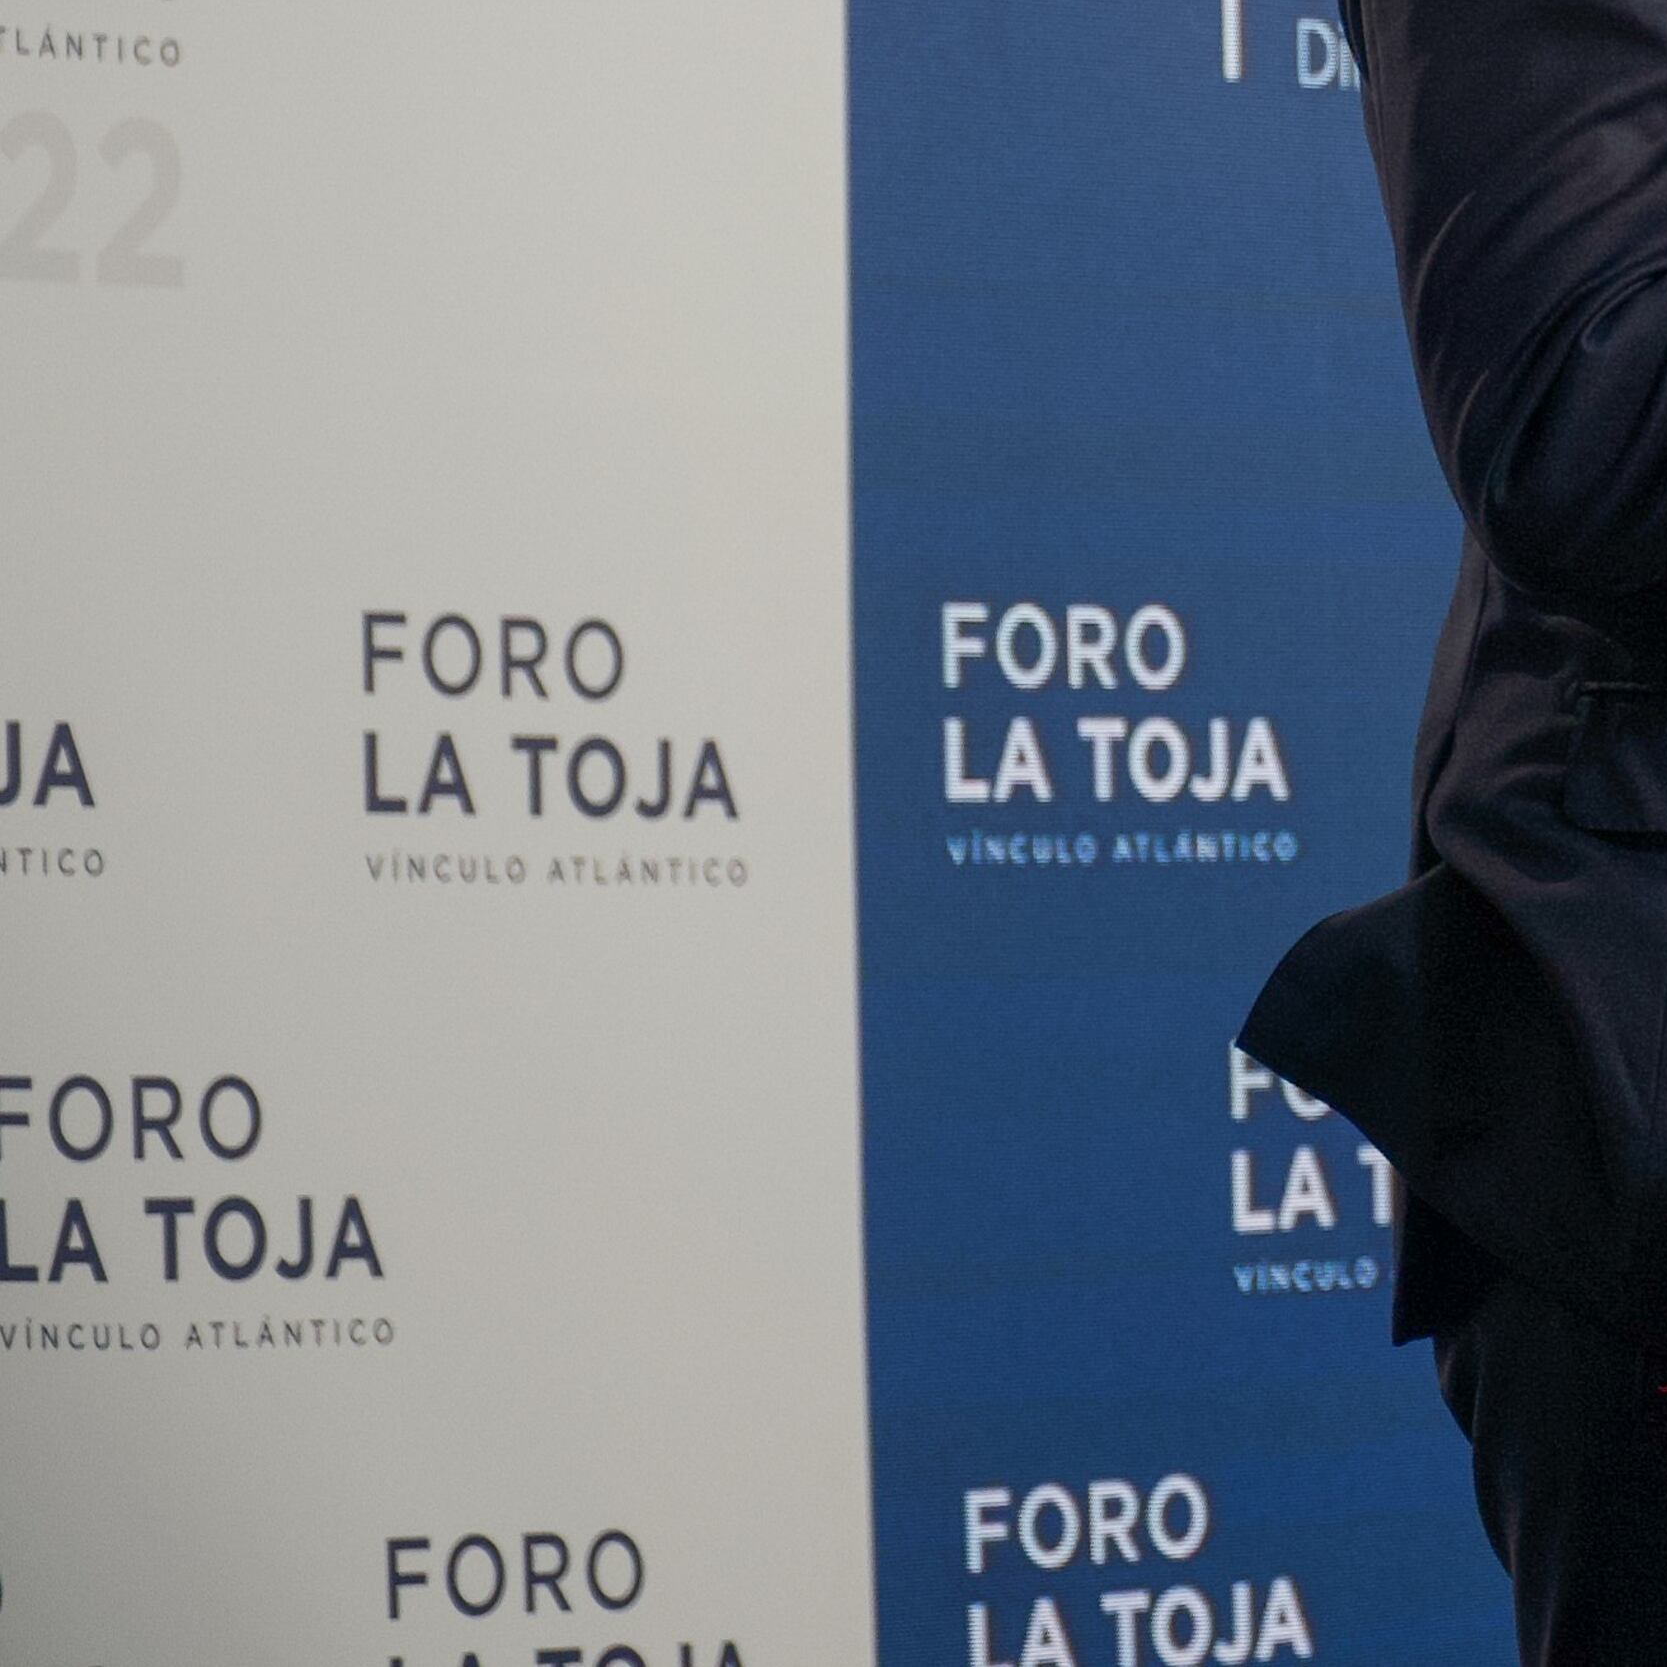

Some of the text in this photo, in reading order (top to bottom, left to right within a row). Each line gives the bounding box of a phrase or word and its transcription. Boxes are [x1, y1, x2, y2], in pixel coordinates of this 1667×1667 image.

[361, 611, 626, 701] FORO
[942, 601, 1186, 690] FORO
[364, 731, 740, 820] LA TOJA
[943, 716, 1290, 803] LA TOJA
[366, 850, 751, 887] VÍNCULO ATLÁNTICO
[945, 828, 1299, 867] VÍNCULO ATLÁNTICO
[1229, 1145, 1337, 1233] LA
[0, 1195, 385, 1284] LA TOJA
[0, 1315, 397, 1351] VÍNCULO ATLÁNTICO
[963, 1474, 1209, 1573] FORO
[385, 1529, 646, 1621] FORO
[967, 1577, 1312, 1667] LA TOJA
